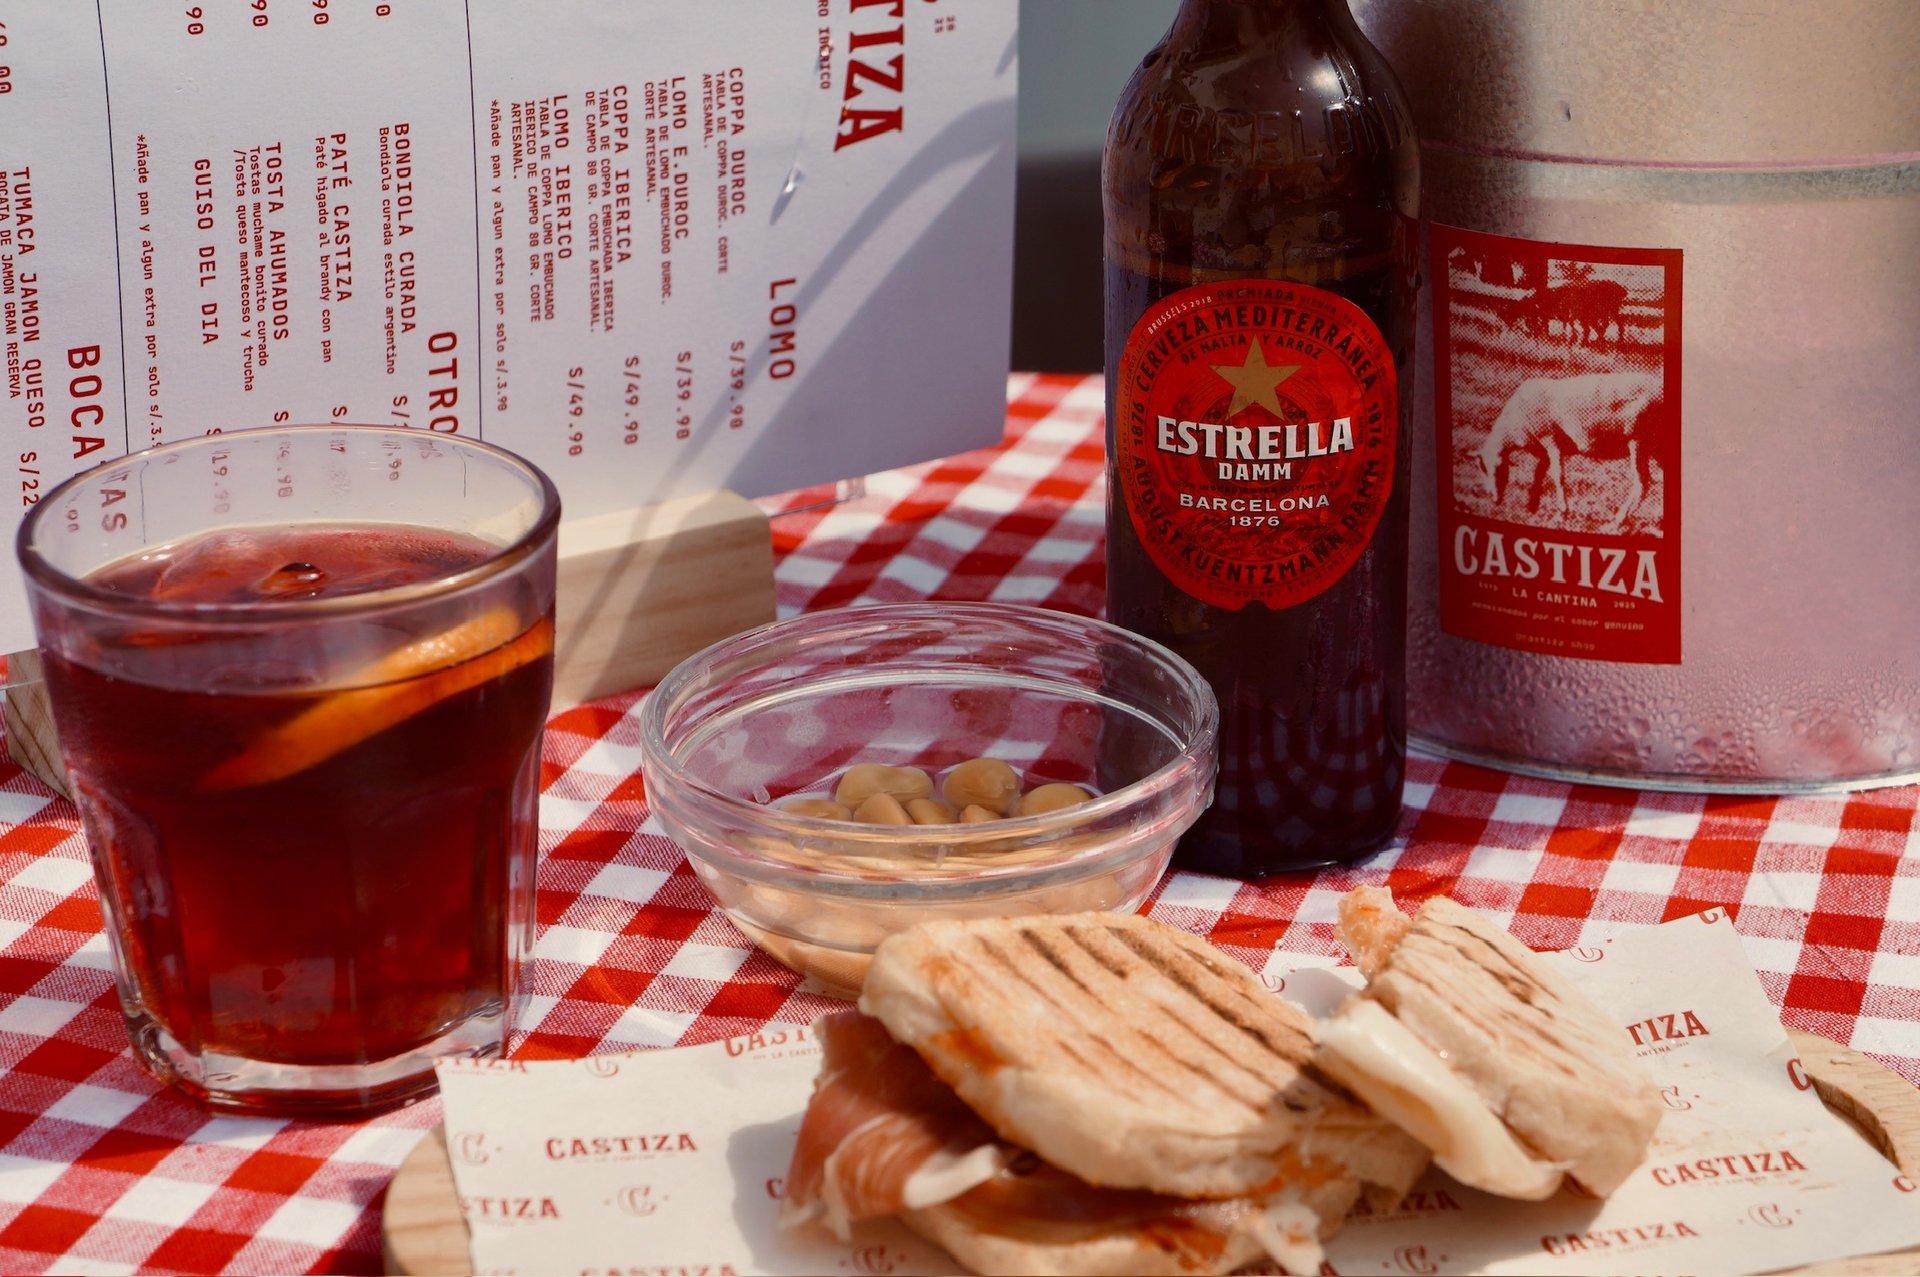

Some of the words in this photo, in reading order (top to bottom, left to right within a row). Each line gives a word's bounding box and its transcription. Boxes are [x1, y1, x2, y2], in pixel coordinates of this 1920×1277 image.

[585, 91, 595, 107] DE
[599, 89, 609, 127] TABLA
[645, 82, 655, 120] CORTE
[658, 80, 668, 118] TABLA
[672, 76, 687, 129] LOMO
[703, 73, 713, 148] ARTESANAL.
[716, 71, 725, 109] TABLA
[729, 67, 745, 135] COPPA
[525, 100, 536, 155] IBERICO
[539, 97, 549, 138] TABLA
[553, 95, 569, 148] LOMO
[586, 114, 597, 153] CAMPO
[613, 85, 629, 154] COPPA
[659, 125, 669, 141] DE
[717, 117, 726, 132] DE
[315, 137, 327, 168] Paté
[331, 133, 352, 189] PATÉ
[379, 127, 391, 191] Bondiola
[511, 103, 523, 179] ARTESANAL.
[541, 145, 550, 160] DE
[600, 135, 610, 150] DE
[717, 140, 727, 178] COPPA
[233, 150, 247, 197] /Tosta
[250, 146, 261, 195] Tostas
[266, 142, 284, 213] TOSTA
[394, 123, 413, 236] BONDIOLA
[490, 155, 500, 178] pan
[527, 162, 537, 178] DE
[601, 158, 611, 197] COPPA
[659, 149, 669, 179] LOMO
[731, 150, 745, 216] DUROC
[137, 192, 149, 215] pan
[194, 159, 213, 230] GUISO
[316, 176, 329, 224] higado
[528, 186, 538, 225] CAMPO
[541, 168, 552, 207] COPPA
[673, 146, 689, 239] E.DUROC
[13, 166, 35, 255] TUMACA
[236, 205, 247, 244] queso
[253, 202, 264, 257] muchame
[382, 199, 393, 245] curada
[492, 201, 504, 240] algun
[543, 214, 553, 245] LOMO
[556, 165, 572, 259] IBERICO
[589, 214, 599, 252] CORTE
[615, 169, 631, 263] IBERICA
[660, 187, 671, 254] EMBUCHADO
[0, 230, 12, 246] DE
[141, 240, 154, 280] algun
[319, 232, 330, 248] al
[334, 205, 352, 302] CASTIZA
[602, 204, 613, 272] EMBUCHADA
[1, 254, 15, 294] JAMON
[199, 246, 216, 287] DEL
[240, 252, 251, 323] mantecoso
[255, 265, 267, 312] bonito
[270, 230, 289, 340] AHUMADOS
[320, 255, 332, 301] brandy
[384, 253, 395, 299] estilo
[495, 247, 505, 285] extra
[544, 252, 554, 320] EMBUCHADO
[20, 273, 40, 342] JAMON
[145, 288, 156, 327] extra
[399, 251, 416, 333] CURADA
[494, 292, 504, 315] por
[530, 284, 541, 322] CORTE
[603, 280, 614, 332] IBERICA
[1216, 287, 1294, 300] PREMIADA
[4, 302, 17, 335] GRAN
[201, 303, 219, 344] DIA
[322, 309, 330, 333] con
[384, 306, 397, 374] argentino
[496, 323, 507, 352] solo
[769, 278, 797, 379] LOMO
[145, 335, 156, 358] por
[257, 320, 269, 366] curado
[321, 340, 331, 363] pan
[1136, 315, 1210, 392] CERVEZA
[1180, 349, 1197, 365] DE
[1200, 333, 1247, 354] MALTA
[1262, 333, 1272, 344] Y
[1275, 335, 1323, 360] ARROZ
[1213, 305, 1377, 390] MEDITERRÁNEA
[7, 342, 21, 398] RESERVA
[149, 366, 160, 396] solo
[243, 345, 254, 391] trucha
[428, 331, 459, 433] OTRO
[22, 359, 45, 428] QUESO
[67, 344, 105, 459] BOCA
[567, 367, 584, 456] S/49.90
[623, 356, 641, 445] S/49.90
[676, 351, 692, 439] S/39.90
[1132, 401, 1145, 447] 1876
[1157, 415, 1355, 460] ESTRELLA
[1368, 402, 1382, 447] 1876
[19, 451, 40, 517] S/22.
[1218, 463, 1291, 480] DAMM
[1132, 456, 1184, 545] AUGUST
[1181, 530, 1344, 584] KUENTZMANN
[1342, 459, 1380, 531] DAMM
[1179, 493, 1330, 512] BARCELONA
[1230, 516, 1280, 527] 1876
[1454, 525, 1664, 603] CASTIZA
[1512, 587, 1528, 599] LA
[1537, 591, 1598, 608] CANTINA
[545, 1132, 697, 1160] CASTIZA
[1652, 1149, 1807, 1188] CASTIZA
[1541, 1220, 1699, 1256] CASTIZA
